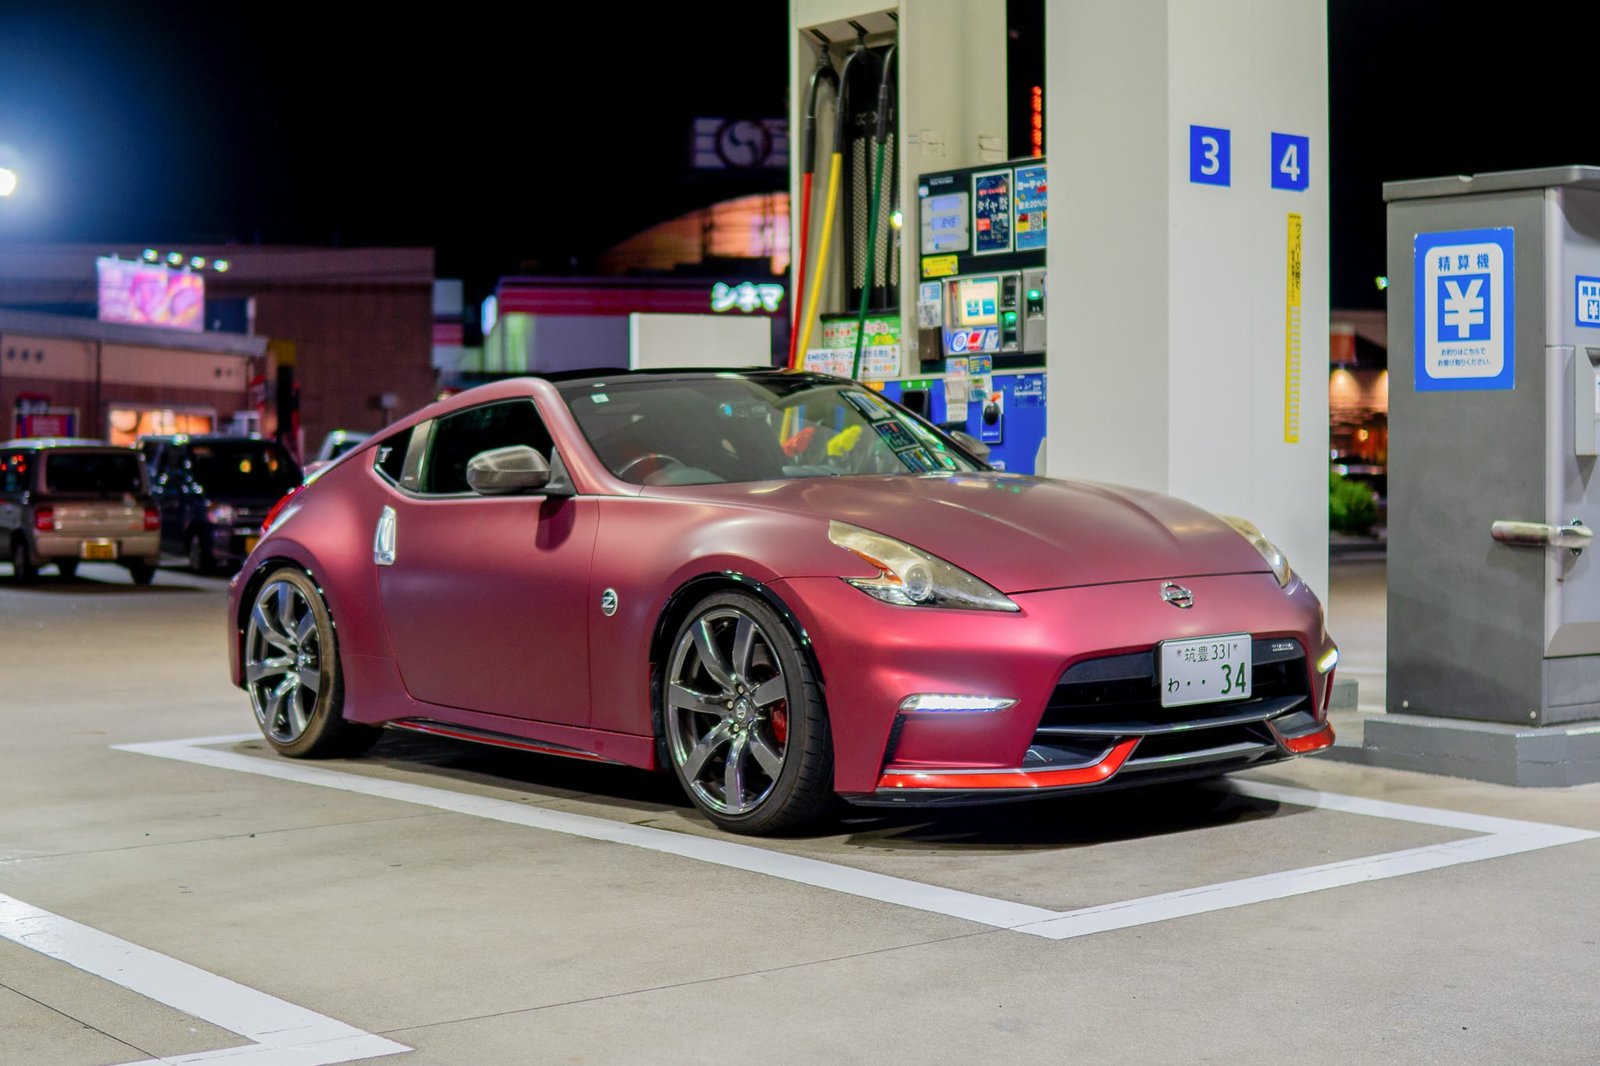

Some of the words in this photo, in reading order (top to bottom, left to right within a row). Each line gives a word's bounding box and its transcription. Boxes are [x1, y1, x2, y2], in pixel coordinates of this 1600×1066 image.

[1200, 136, 1220, 176] 3
[1279, 144, 1300, 182] 4
[1437, 253, 1490, 272] 精算機
[711, 281, 785, 313] シネマ
[1221, 662, 1246, 695] 34
